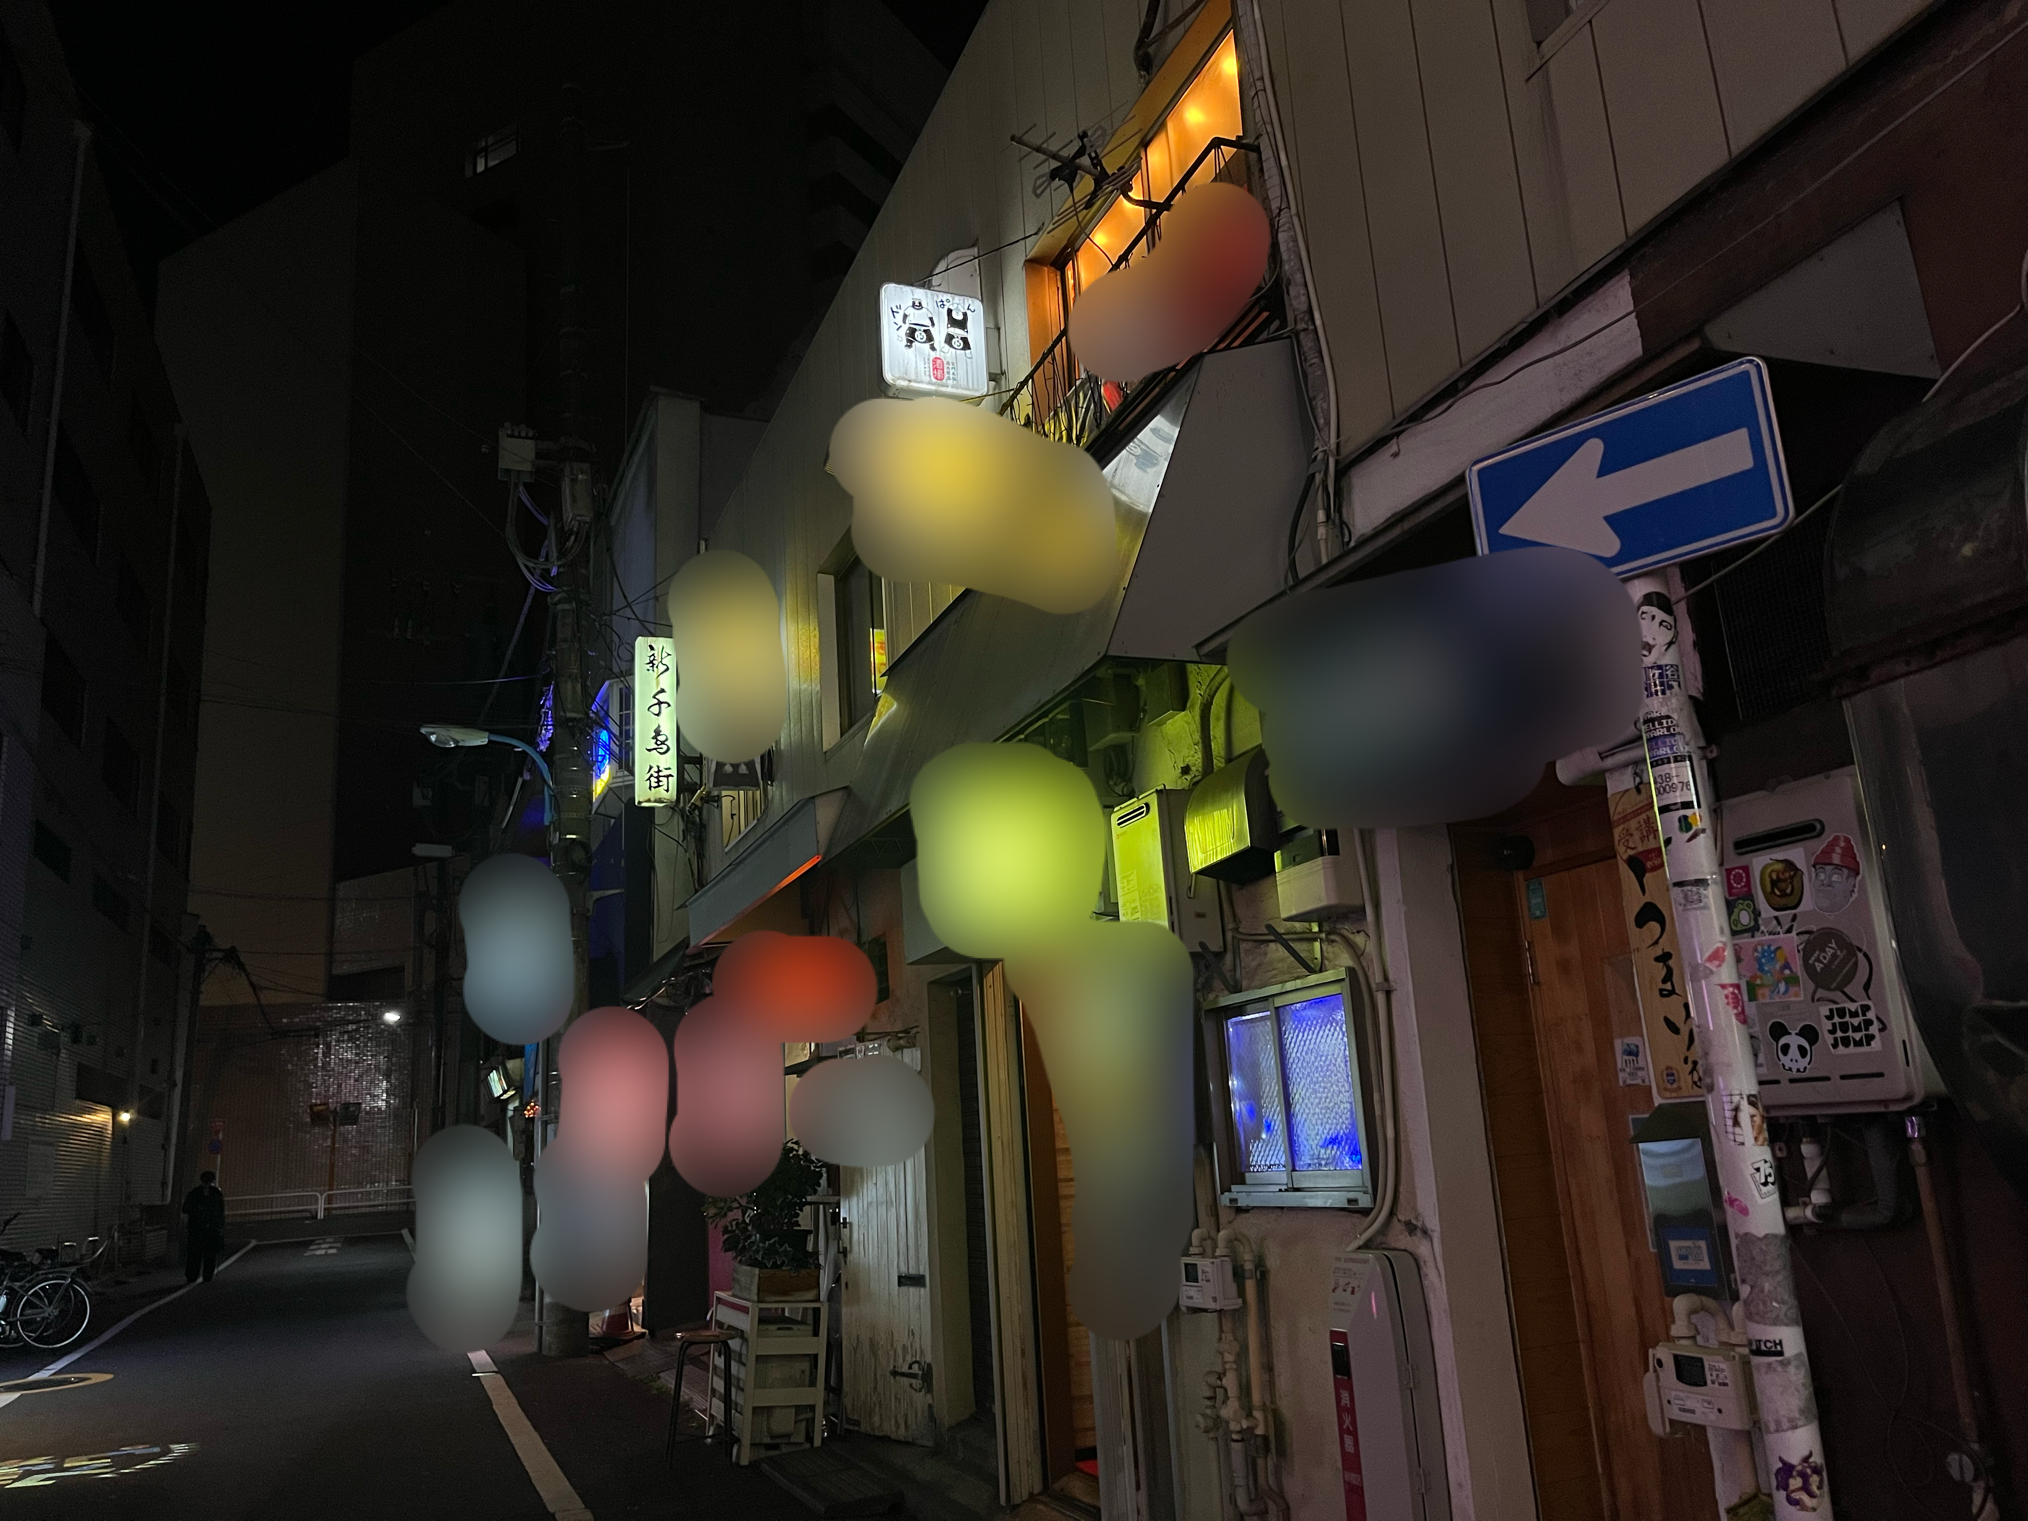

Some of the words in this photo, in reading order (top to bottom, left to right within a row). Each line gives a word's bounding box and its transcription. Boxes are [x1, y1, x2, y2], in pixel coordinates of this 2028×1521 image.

[1824, 1003, 1872, 1021] JUMP
[1827, 1018, 1875, 1035] JUMP
[1830, 1032, 1876, 1049] JUMP
